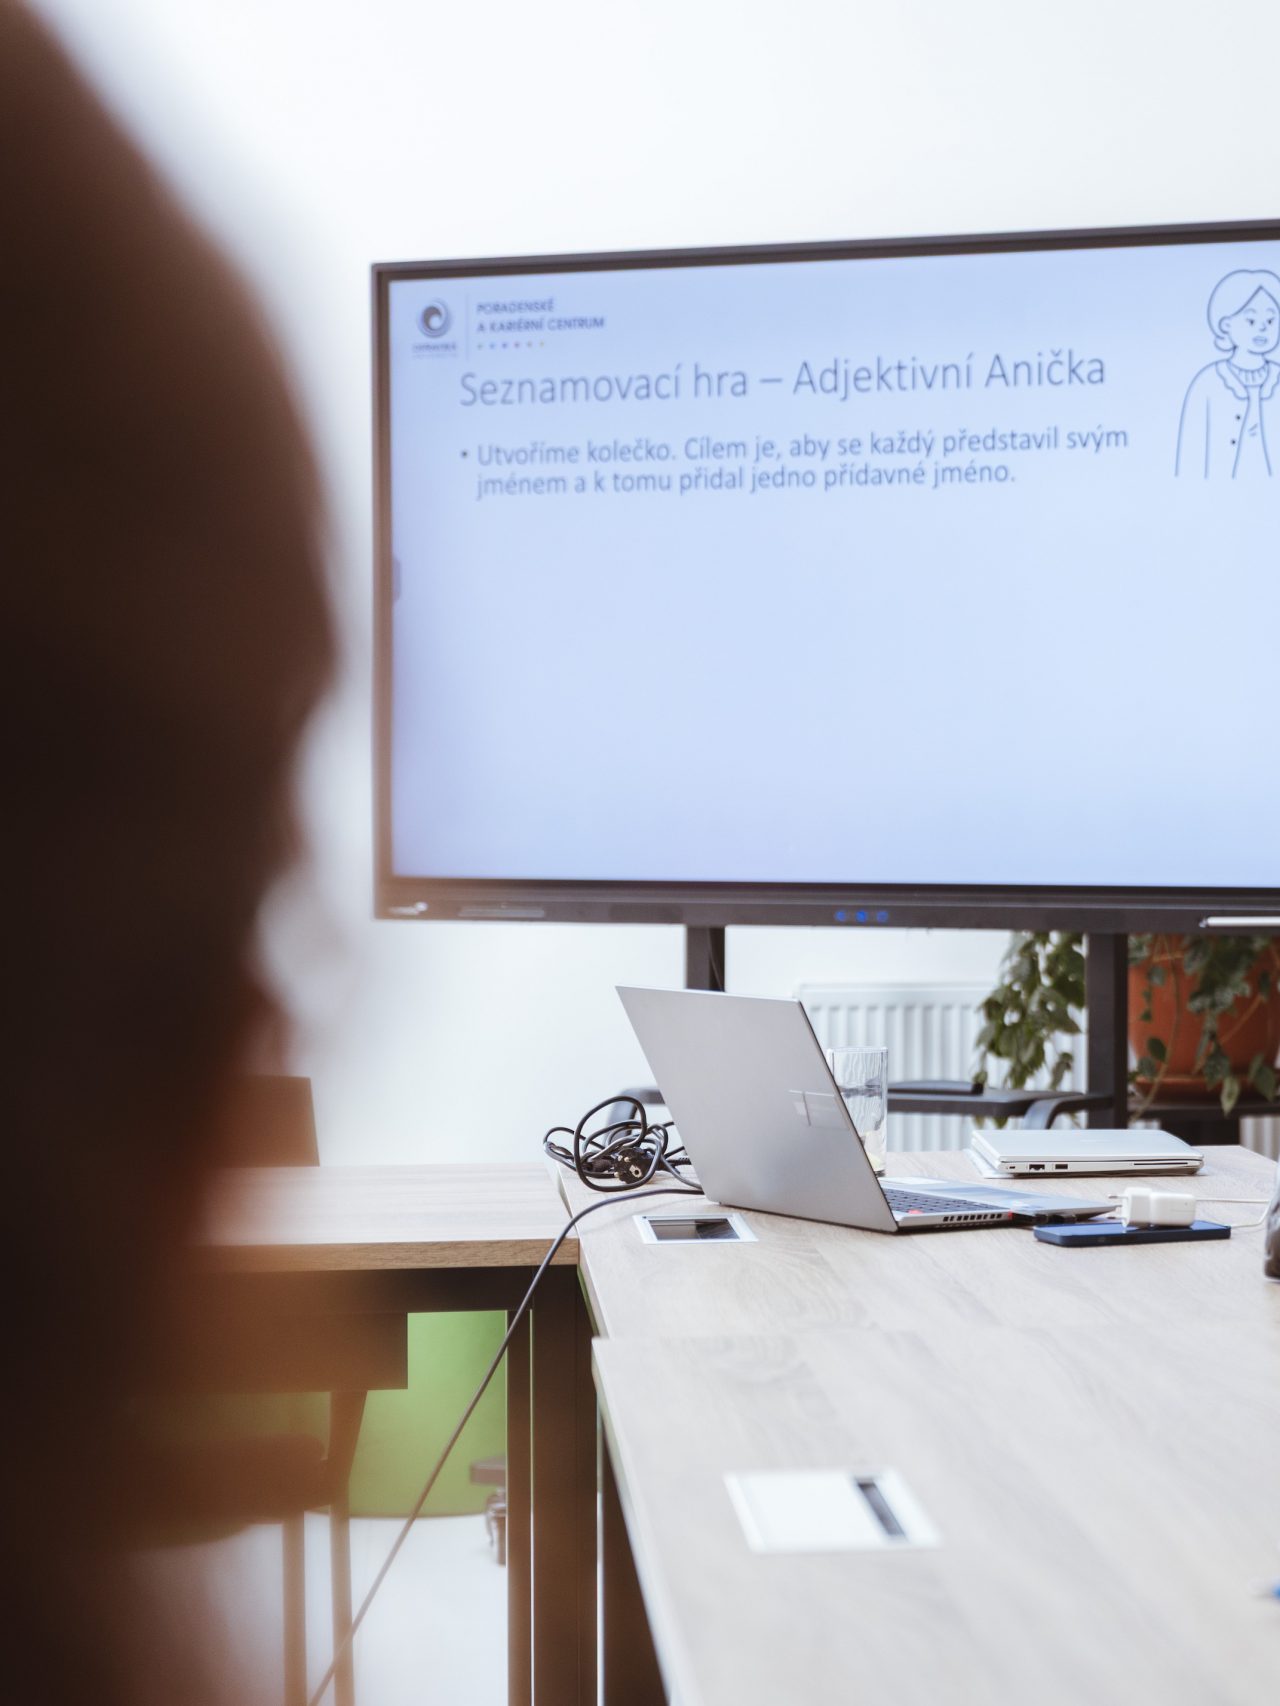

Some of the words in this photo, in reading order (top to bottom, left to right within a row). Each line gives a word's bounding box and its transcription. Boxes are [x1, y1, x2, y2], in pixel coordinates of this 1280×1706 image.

[477, 298, 554, 314] PORADENSKÉ
[477, 322, 485, 332] A
[490, 317, 544, 332] KARIÉRNÍ
[548, 317, 605, 330] CENTRUM
[460, 363, 681, 406] Seznamovací
[693, 362, 748, 398] hra
[792, 352, 973, 402] Adjektivní
[984, 348, 1106, 387] Anička
[477, 441, 579, 466] Utvoříme
[587, 438, 676, 464] kolečko.
[684, 436, 746, 460] Cílem
[754, 435, 782, 463] je,
[790, 433, 830, 461] aby
[838, 440, 861, 456] se
[870, 429, 935, 458] každý
[942, 427, 1059, 458] představil
[1066, 424, 1127, 453] svým
[476, 474, 566, 501] jménem
[574, 477, 586, 494] a
[594, 469, 605, 493] k
[613, 471, 671, 492] tomu
[679, 466, 743, 495] přidal
[751, 465, 816, 493] jedno
[824, 461, 925, 491] přídavné
[932, 460, 1015, 489] jméno.
